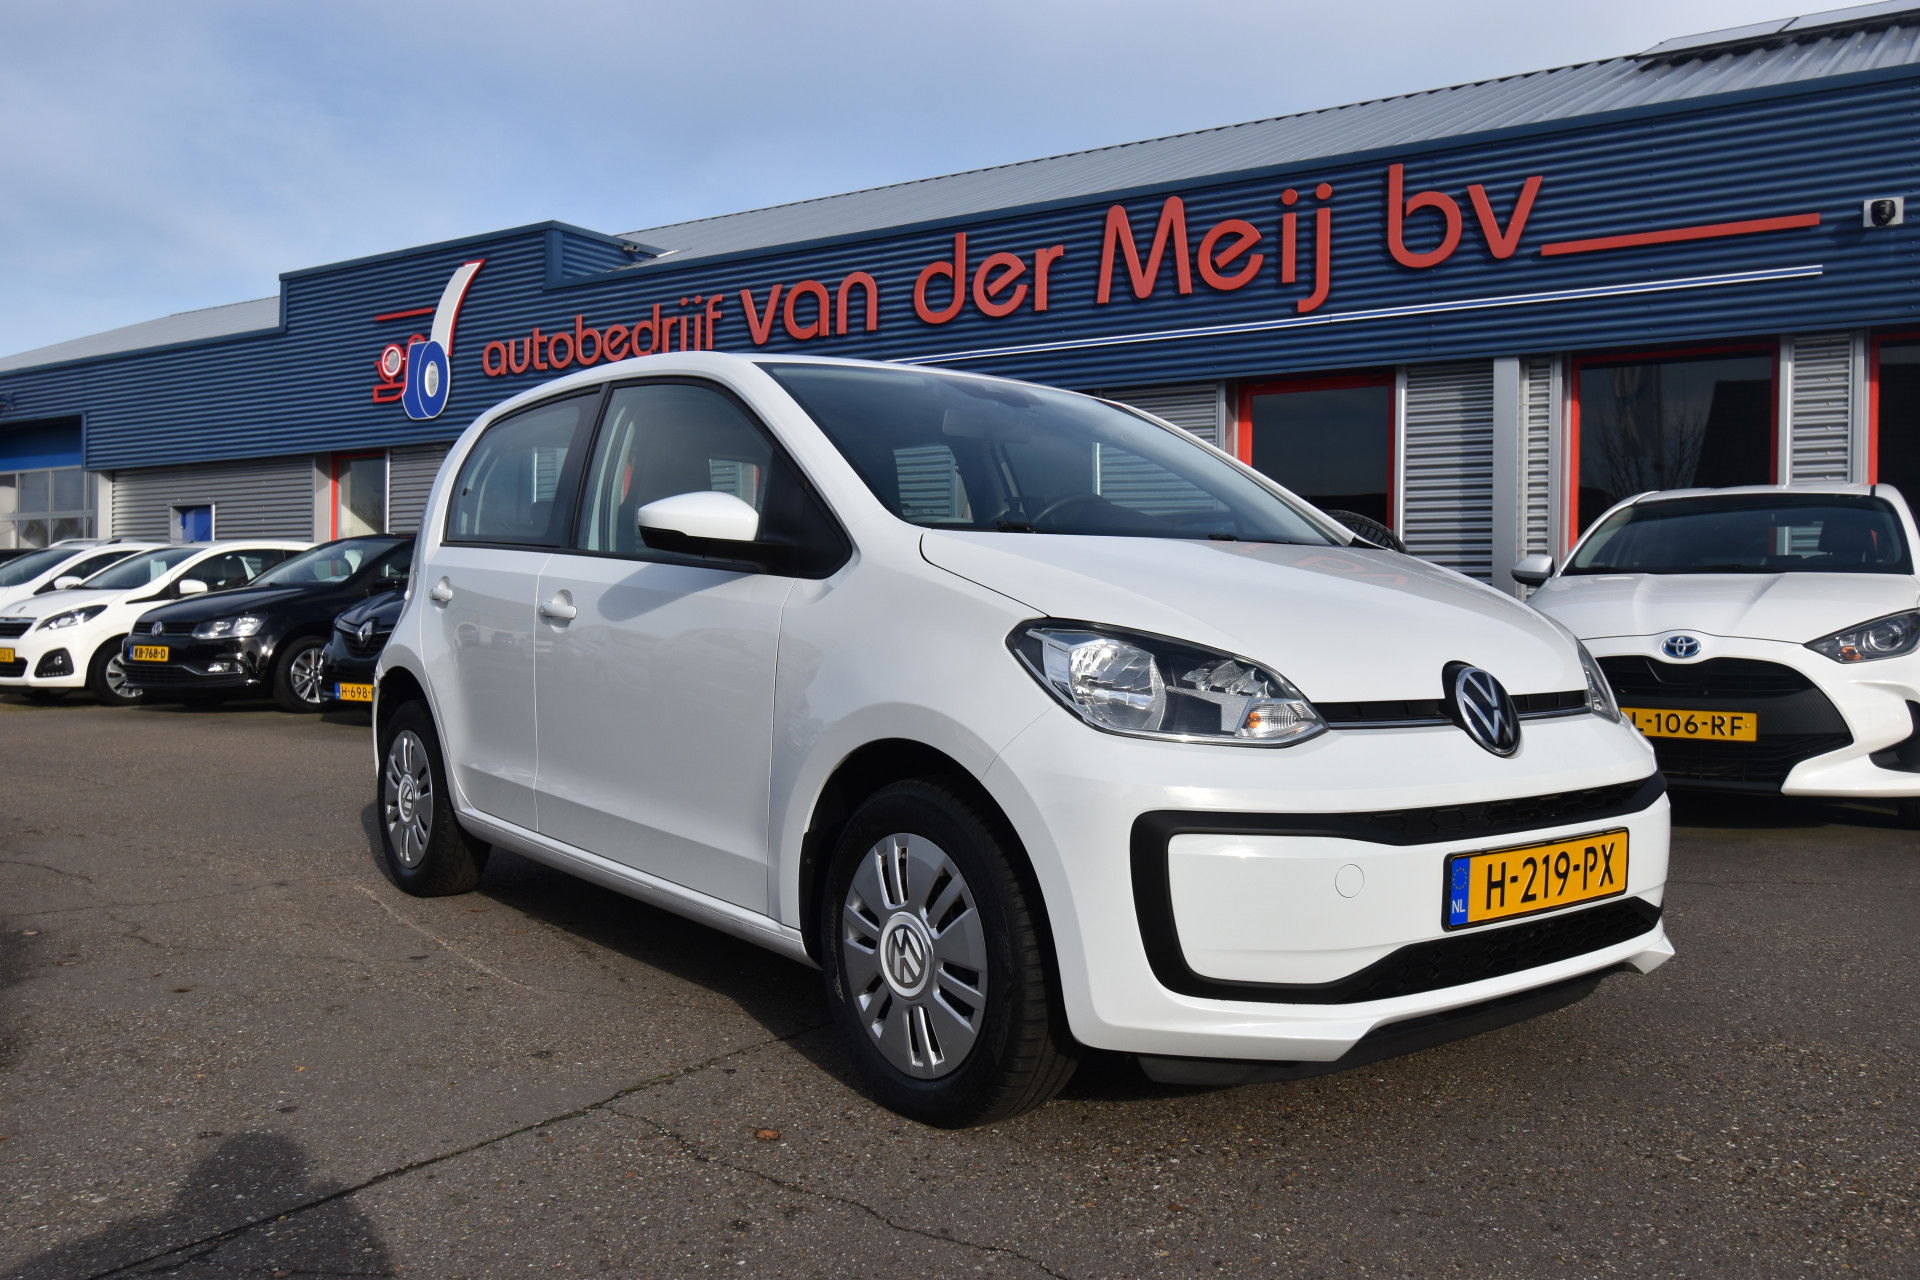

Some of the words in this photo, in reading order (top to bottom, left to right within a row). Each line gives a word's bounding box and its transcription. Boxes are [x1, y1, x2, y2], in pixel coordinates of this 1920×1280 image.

[482, 294, 723, 377] autobedrijf
[740, 271, 878, 345] van
[914, 232, 1064, 324] der
[1097, 183, 1332, 312] Meij
[1388, 164, 1543, 268] bv
[1452, 900, 1466, 914] NL
[1486, 842, 1615, 910] H-219-PX
